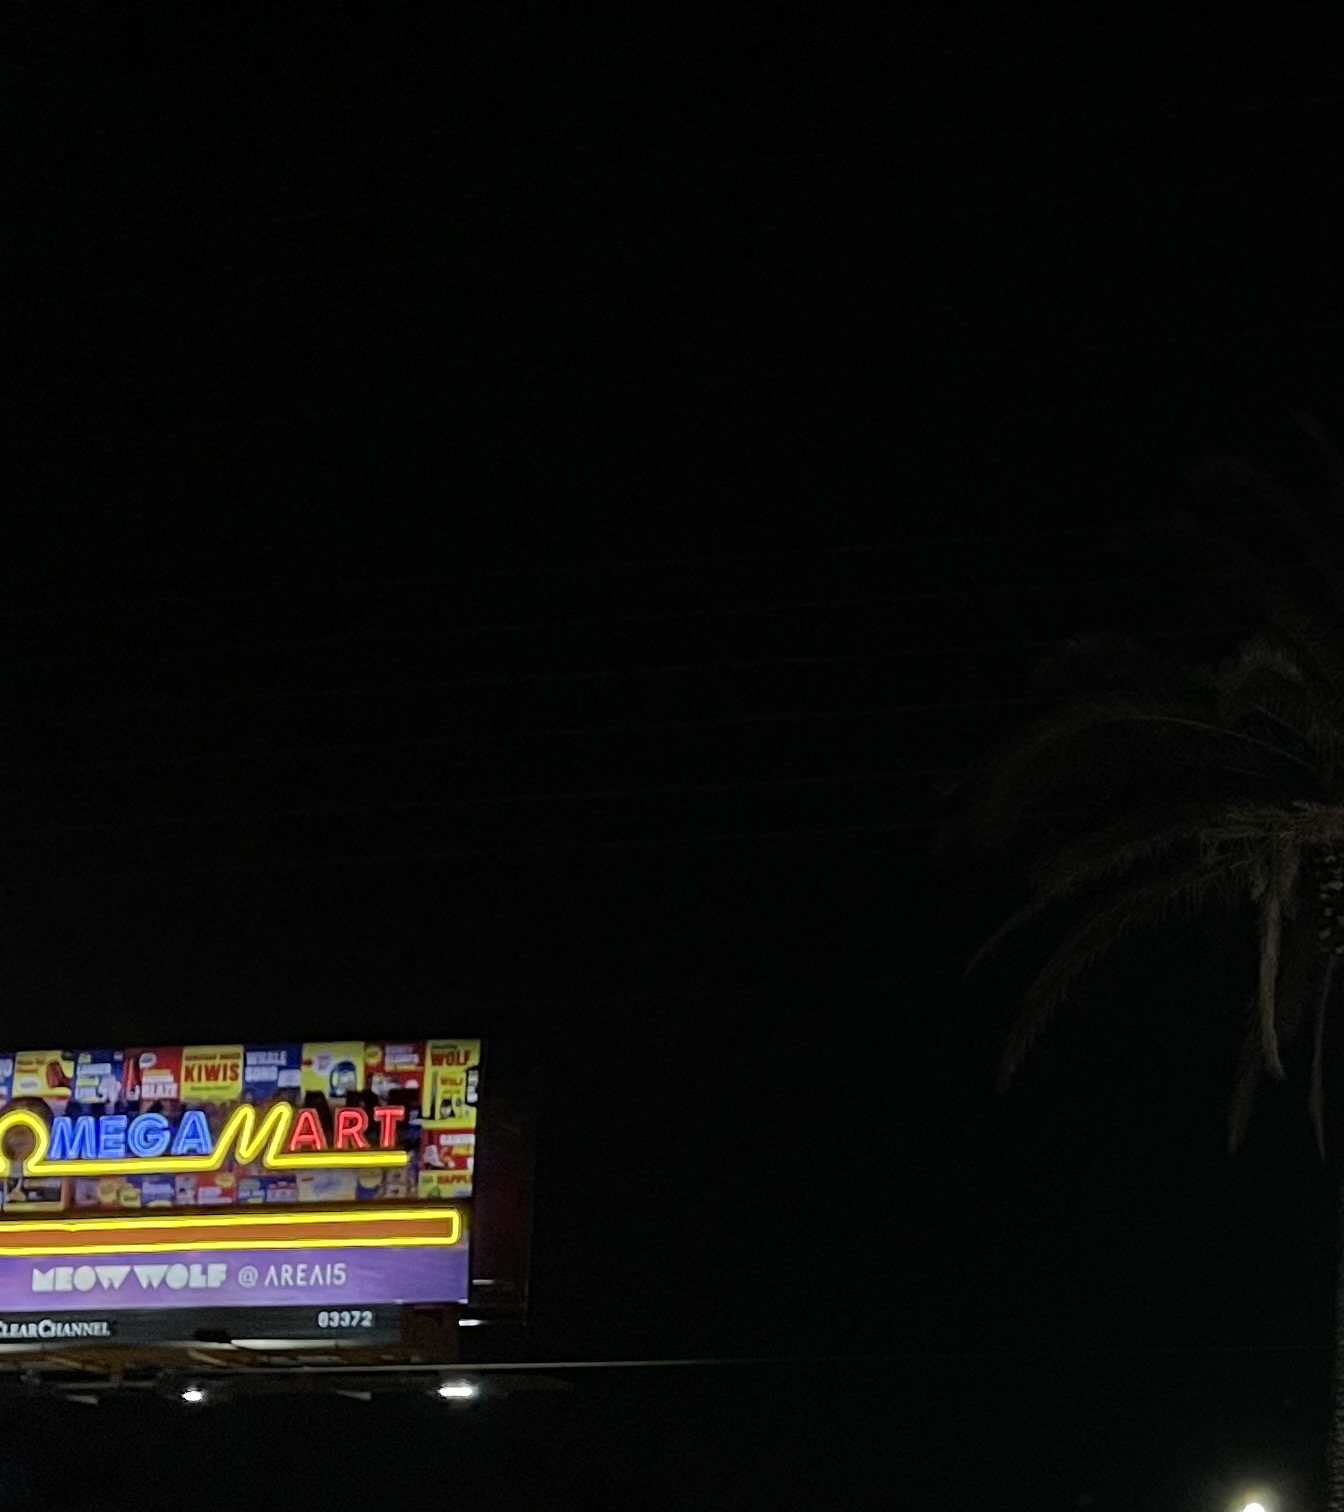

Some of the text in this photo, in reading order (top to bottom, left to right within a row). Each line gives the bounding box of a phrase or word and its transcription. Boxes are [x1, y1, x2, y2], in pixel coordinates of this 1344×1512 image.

[184, 1063, 241, 1082] KIWIS
[32, 1266, 131, 1292] MEOW
[134, 1263, 227, 1290] WOLF
